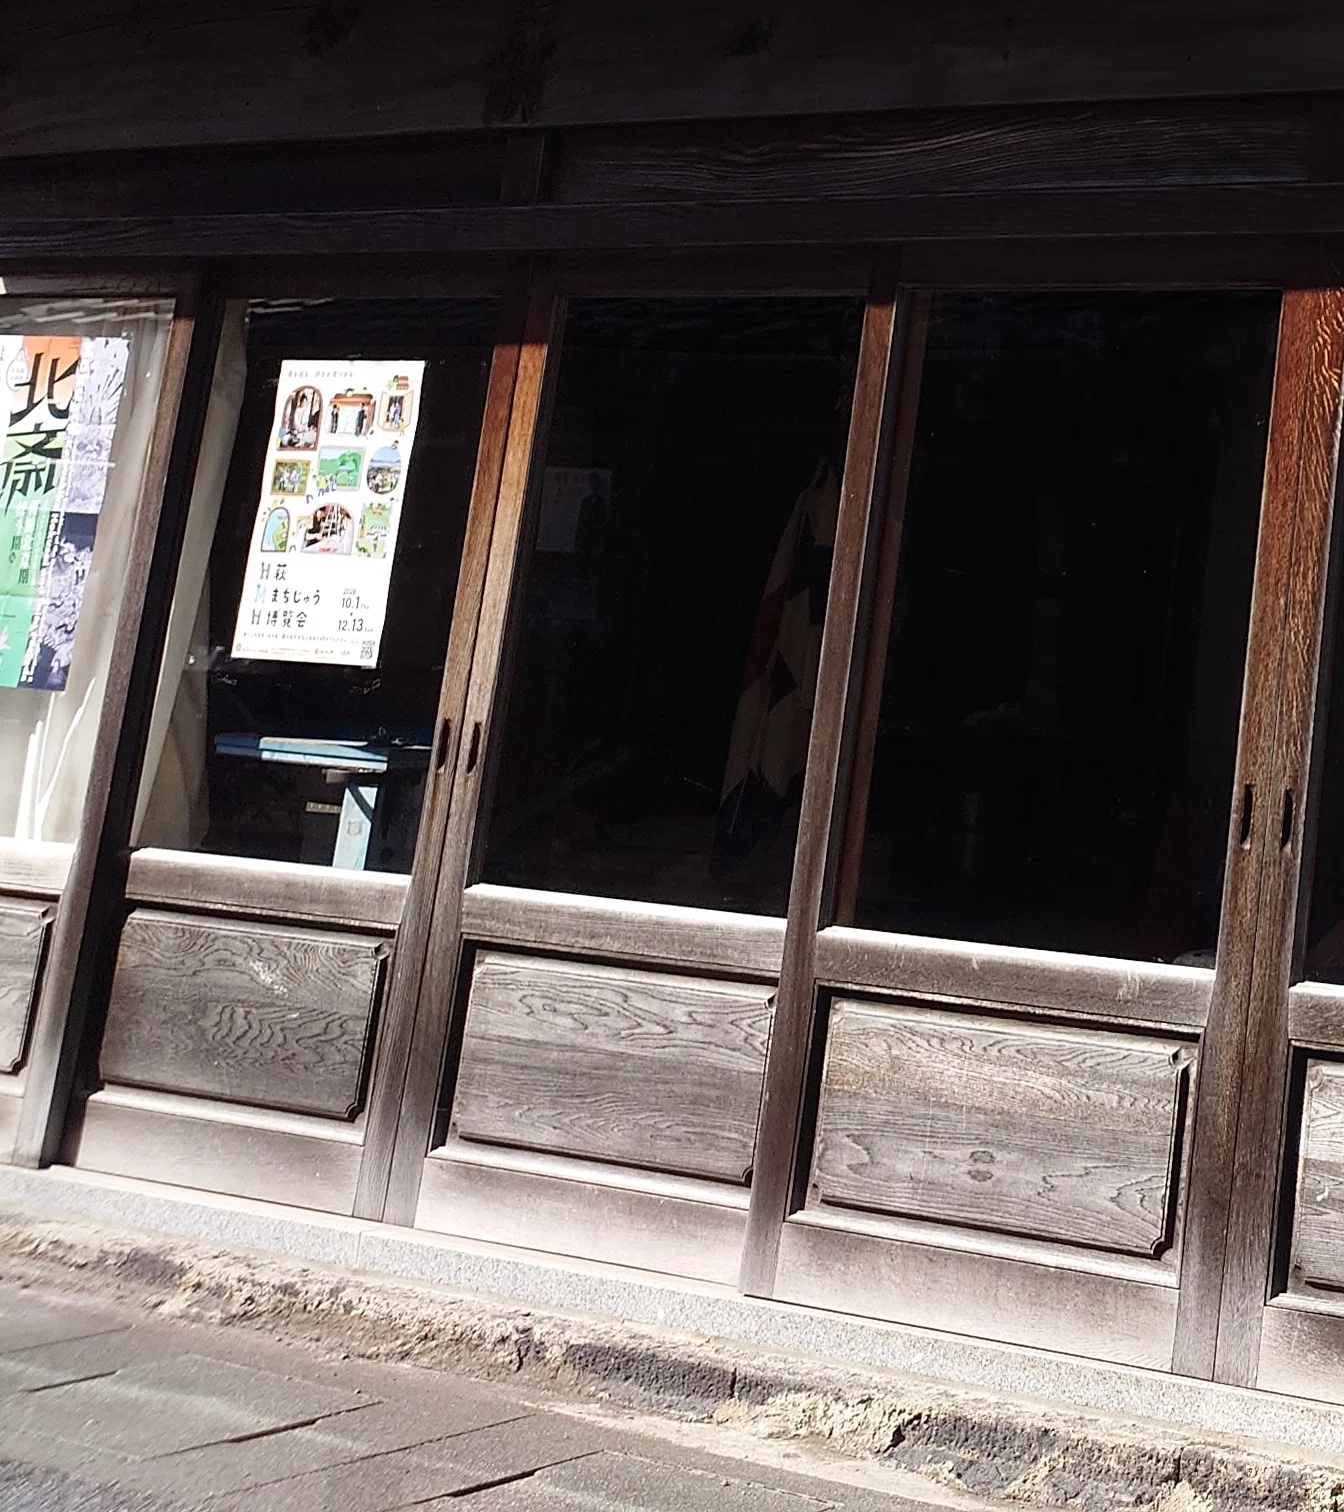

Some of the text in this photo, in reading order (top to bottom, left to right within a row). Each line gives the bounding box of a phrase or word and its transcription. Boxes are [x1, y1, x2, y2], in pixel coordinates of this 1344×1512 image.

[271, 588, 321, 605] まちじゅう
[266, 610, 307, 628] 博覧会
